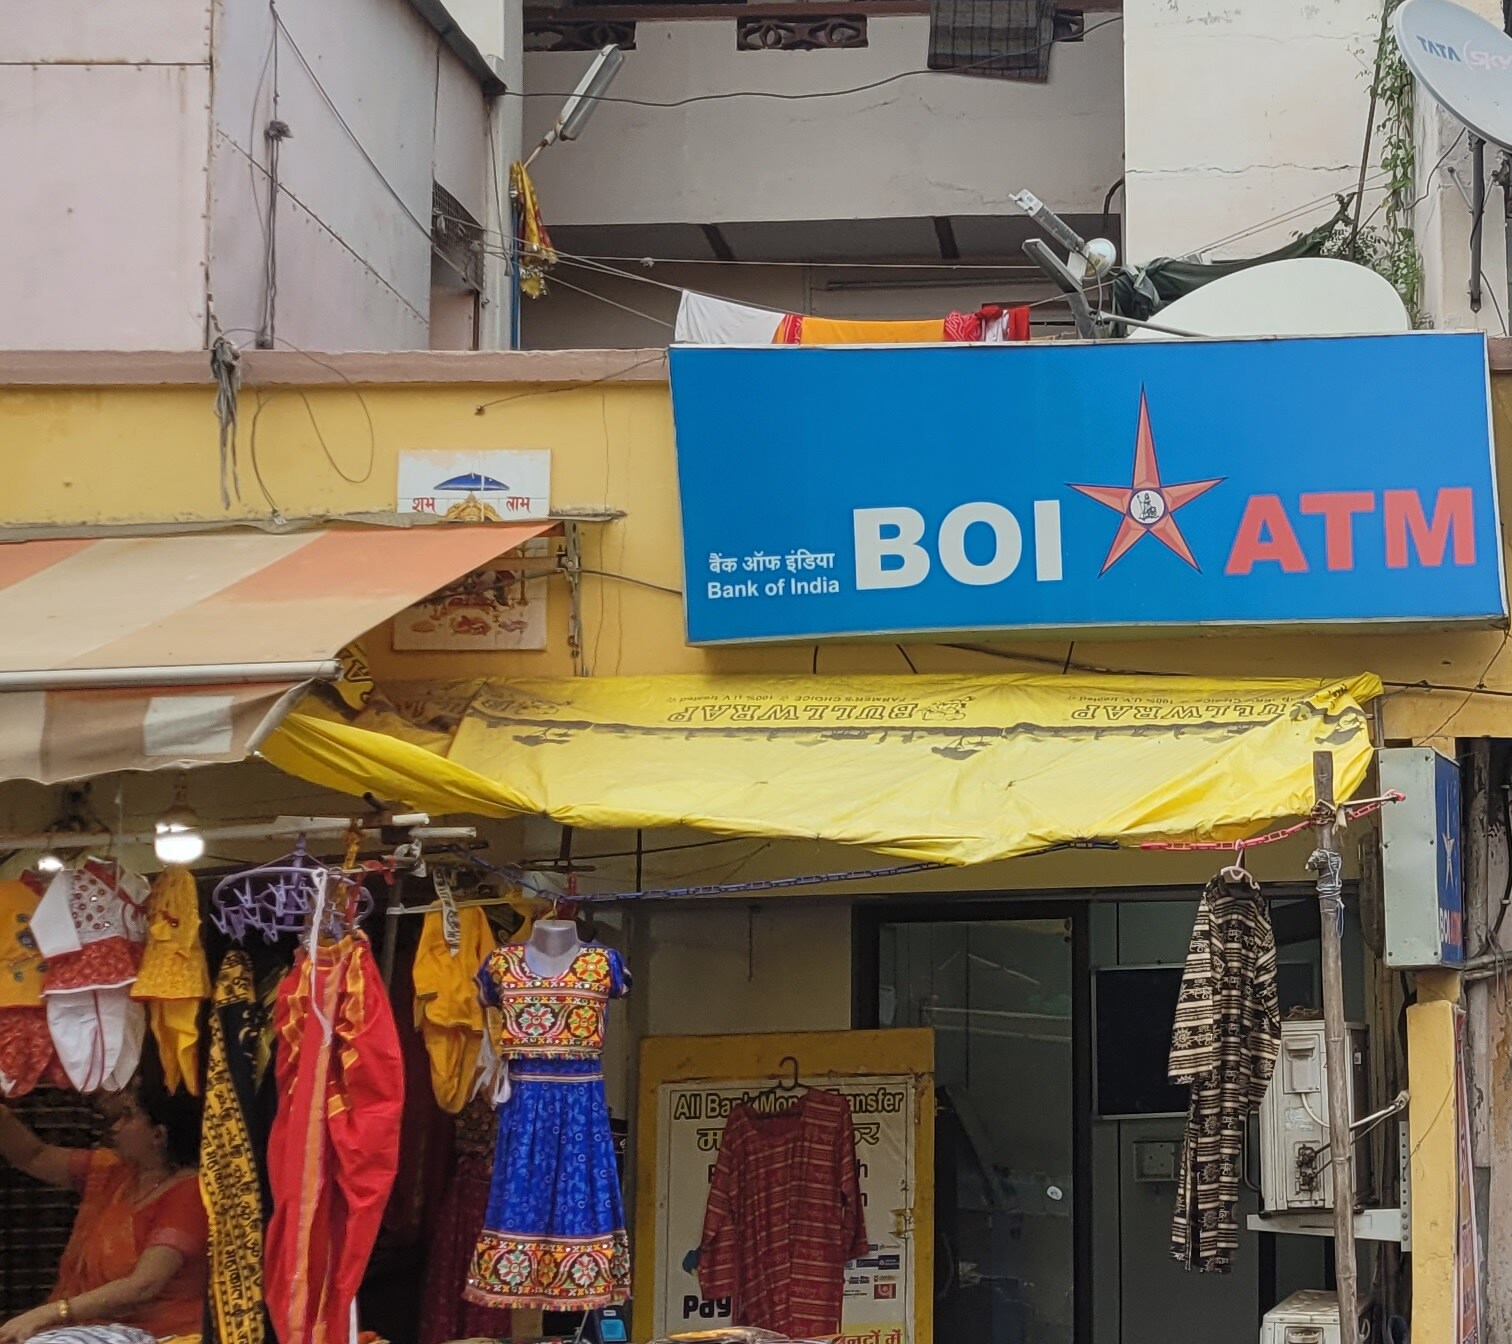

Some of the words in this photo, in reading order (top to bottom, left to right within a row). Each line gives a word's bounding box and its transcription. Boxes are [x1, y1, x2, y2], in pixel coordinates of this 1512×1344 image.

[1416, 35, 1461, 62] TATA
[412, 497, 436, 514] शभ
[506, 496, 531, 513] लाभ
[853, 499, 1063, 590] BOI
[1224, 487, 1477, 576] ATM
[709, 553, 738, 573] बैंक
[742, 550, 781, 572] ऑफ
[785, 549, 835, 573] इंडिया
[707, 580, 759, 599] Bank
[764, 578, 786, 596] of
[791, 576, 840, 595] India
[667, 702, 919, 722] BULLWRAP
[1071, 704, 1286, 720] ULLWRAP
[674, 1093, 702, 1119] All
